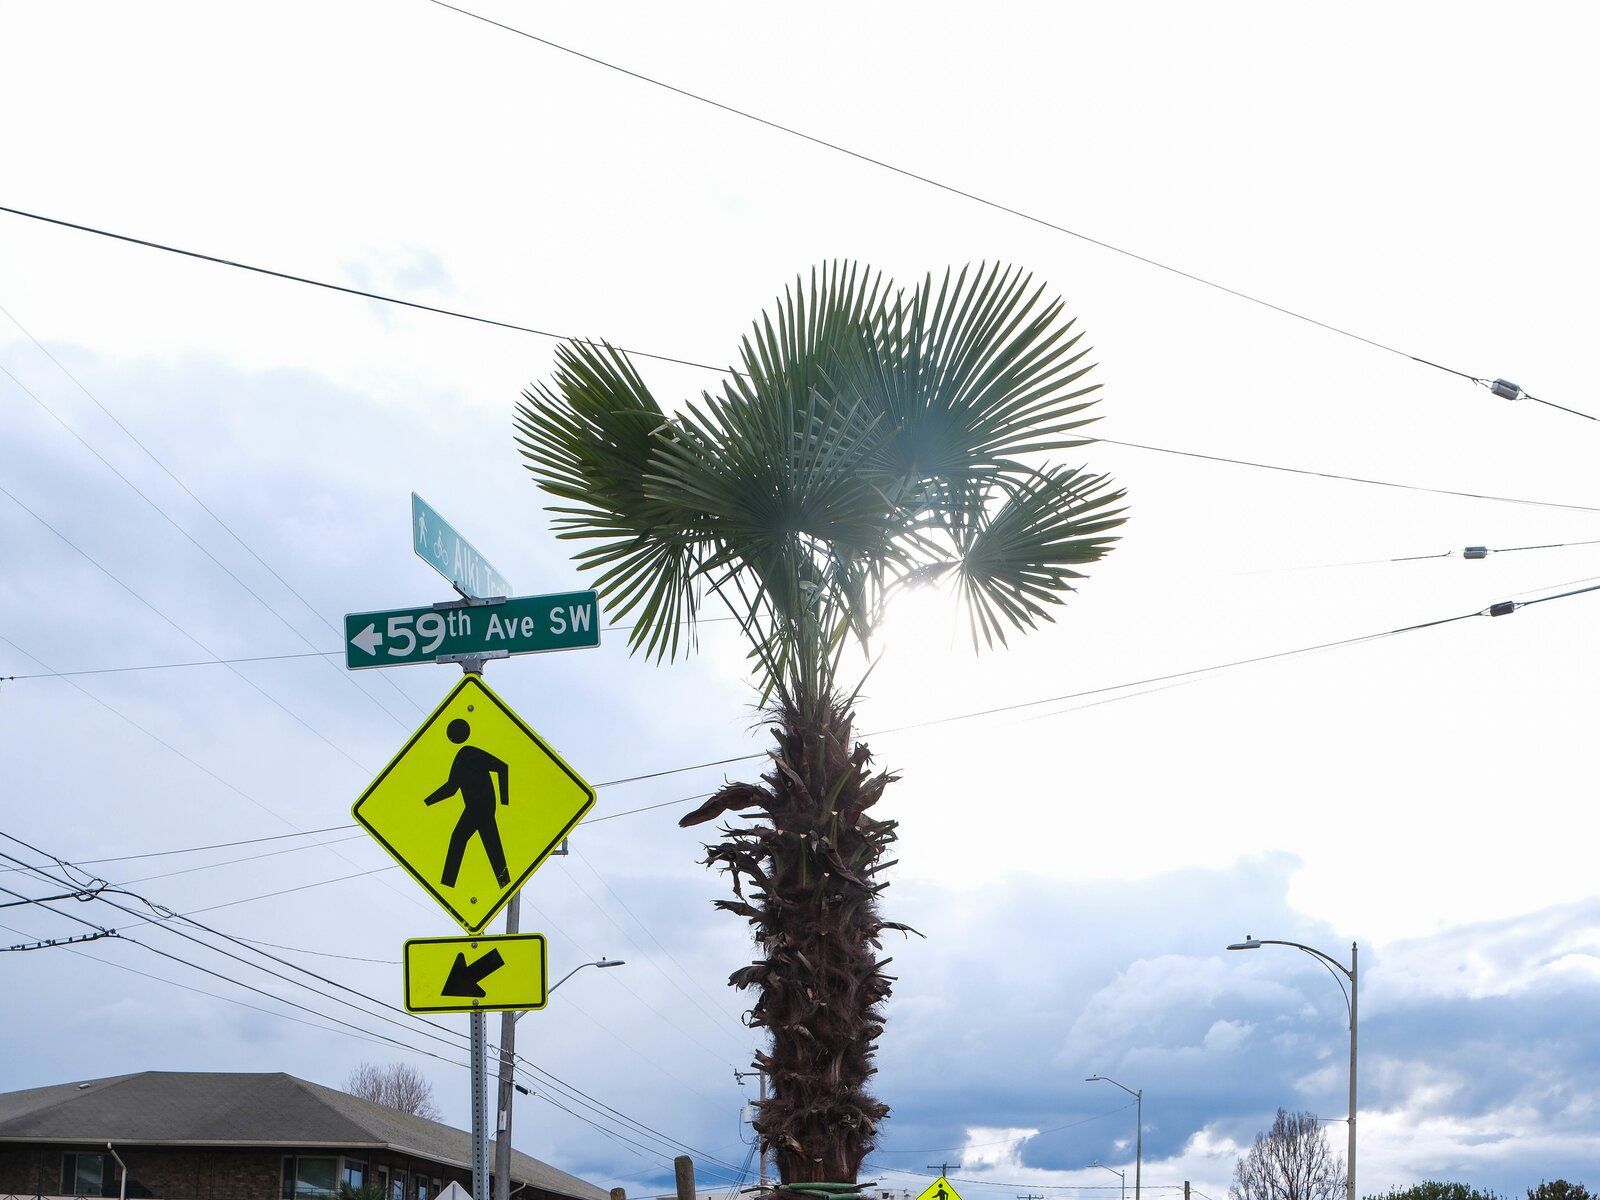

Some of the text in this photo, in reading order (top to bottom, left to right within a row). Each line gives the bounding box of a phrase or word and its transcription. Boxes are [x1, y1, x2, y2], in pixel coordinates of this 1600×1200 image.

[454, 538, 480, 596] Alki
[387, 603, 592, 656] 59th Ave SW
